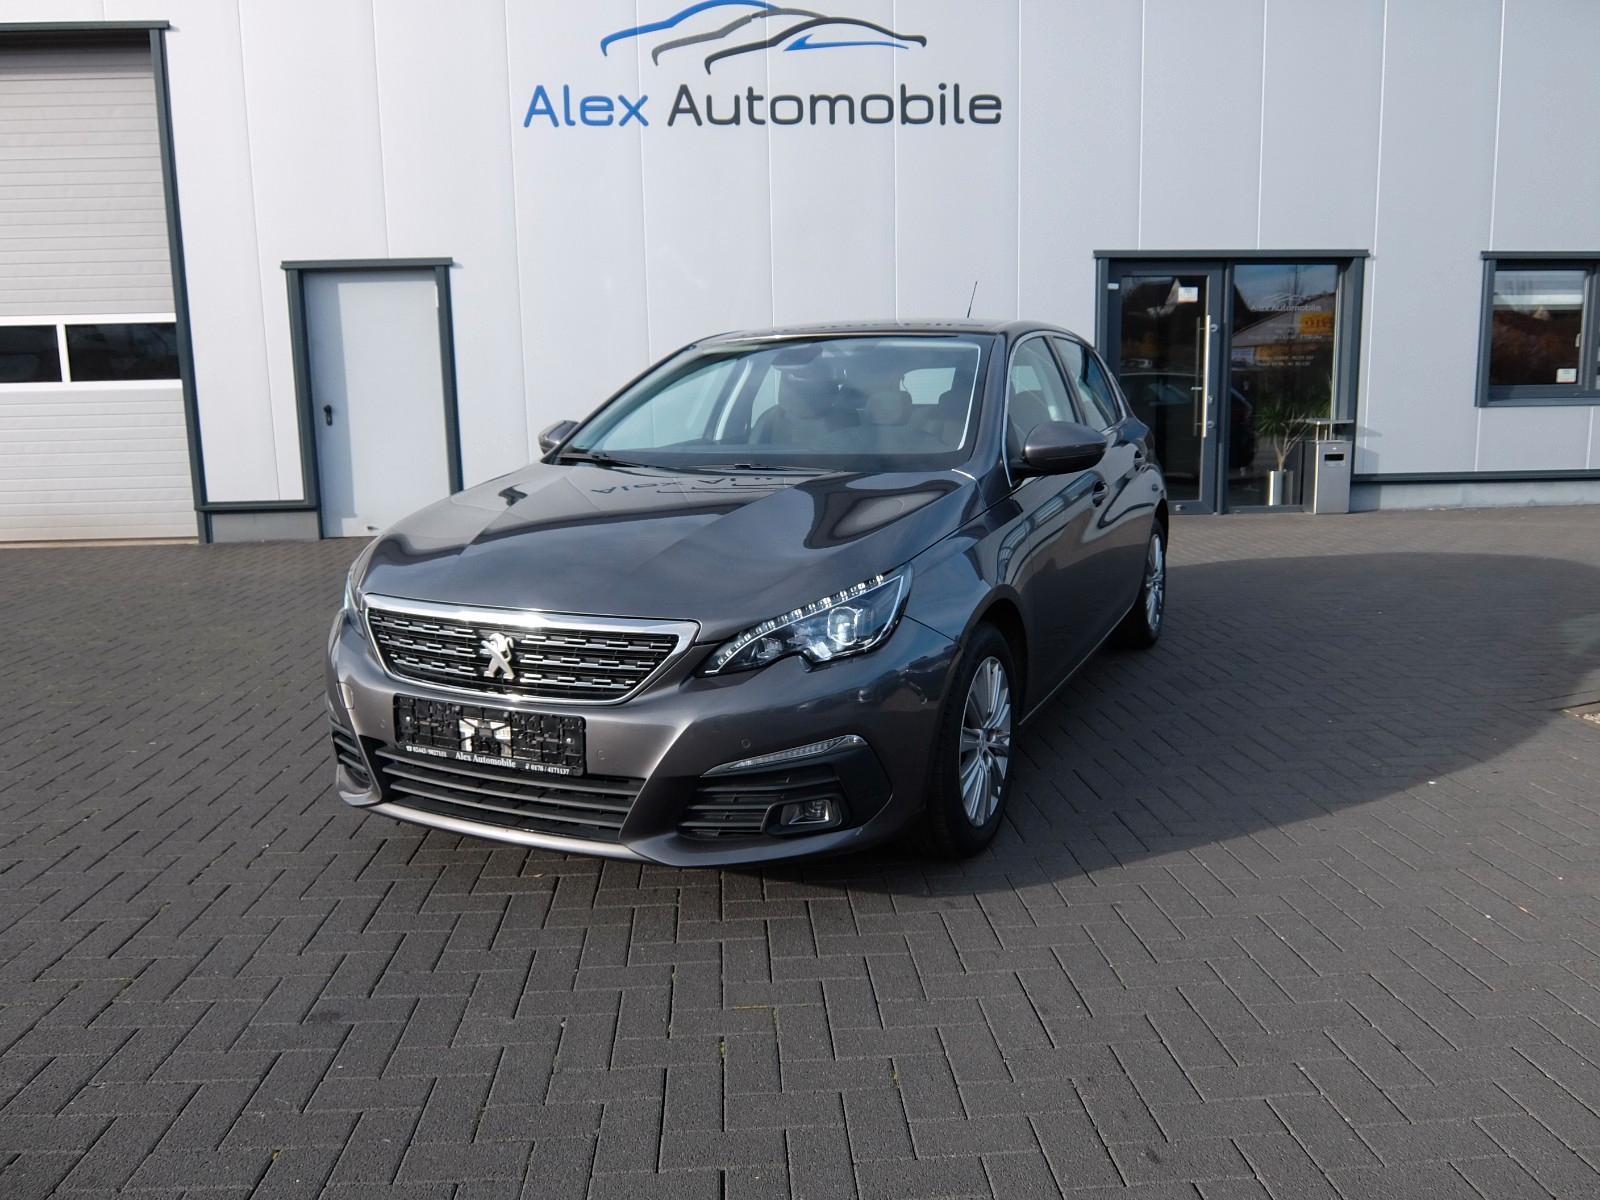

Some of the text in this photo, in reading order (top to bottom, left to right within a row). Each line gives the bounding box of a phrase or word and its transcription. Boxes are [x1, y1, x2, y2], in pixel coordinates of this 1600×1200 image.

[523, 83, 1003, 128] Alex Automobile
[1271, 303, 1322, 312] Automobile
[455, 751, 517, 768] Alex Automobile
